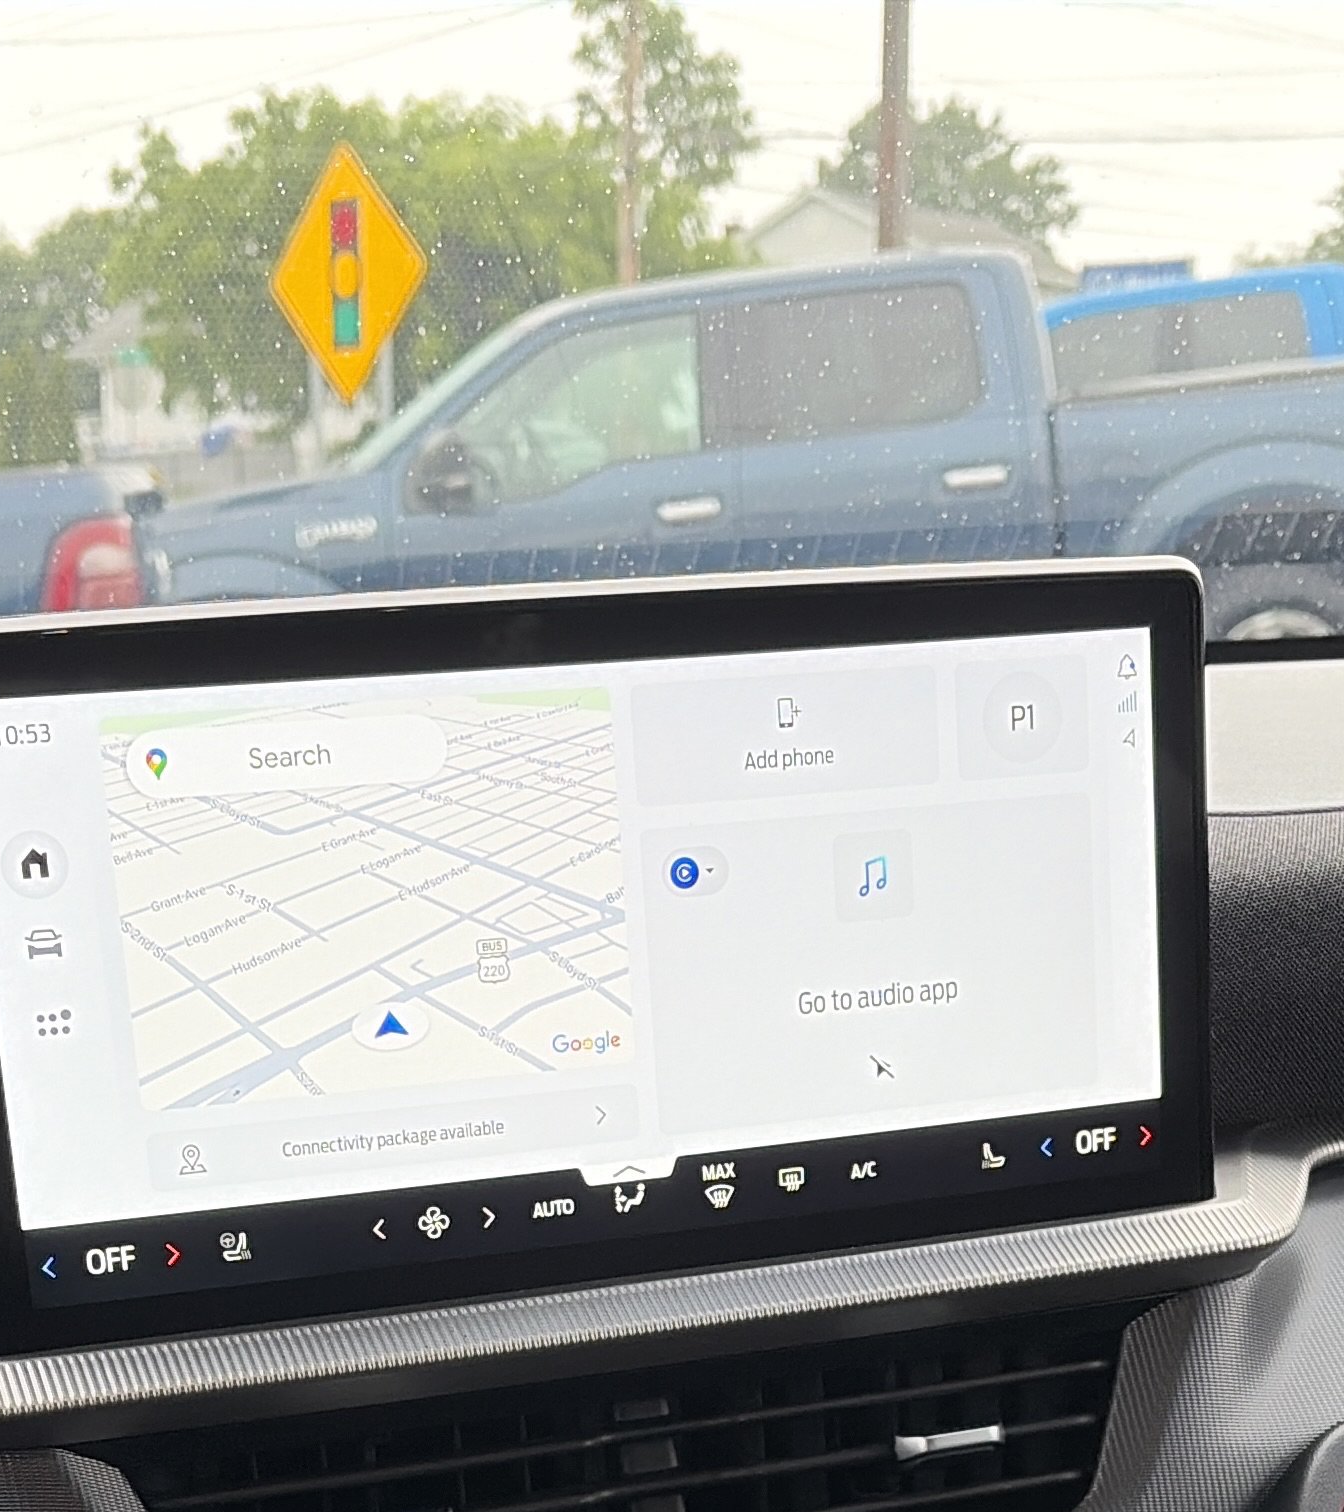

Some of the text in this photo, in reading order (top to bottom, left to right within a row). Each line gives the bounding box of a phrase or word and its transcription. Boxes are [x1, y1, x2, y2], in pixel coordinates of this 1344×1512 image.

[1010, 702, 1035, 731] P1
[248, 743, 331, 769] Search
[744, 745, 835, 771] Add phone
[420, 789, 454, 806] East St
[220, 802, 248, 824] Lloyd
[247, 815, 262, 828] St
[109, 831, 128, 843] Ave
[321, 828, 378, 853] E Grant Ave
[113, 847, 155, 866] Bell Ave
[360, 845, 422, 875] E Logan Ave
[398, 864, 470, 901] E Hudson Ave
[150, 885, 207, 912] Grant Ave
[226, 884, 273, 912] S 1st St
[121, 922, 168, 962] S 2nd St
[184, 914, 247, 947] Logan Ave
[232, 938, 303, 975] Hudson Ave
[482, 941, 503, 951] BUS
[483, 965, 505, 977] 220
[549, 951, 558, 963] S
[585, 976, 597, 990] St
[798, 979, 958, 1015] Go to audio app
[552, 1031, 621, 1054] Google
[297, 1072, 308, 1085] S
[282, 1120, 505, 1157] Connectivity package available
[1075, 1126, 1117, 1155] OFF
[701, 1161, 736, 1182] MAX
[850, 1160, 878, 1180] A/C
[532, 1199, 575, 1219] AUTO
[86, 1244, 136, 1276] OFF
